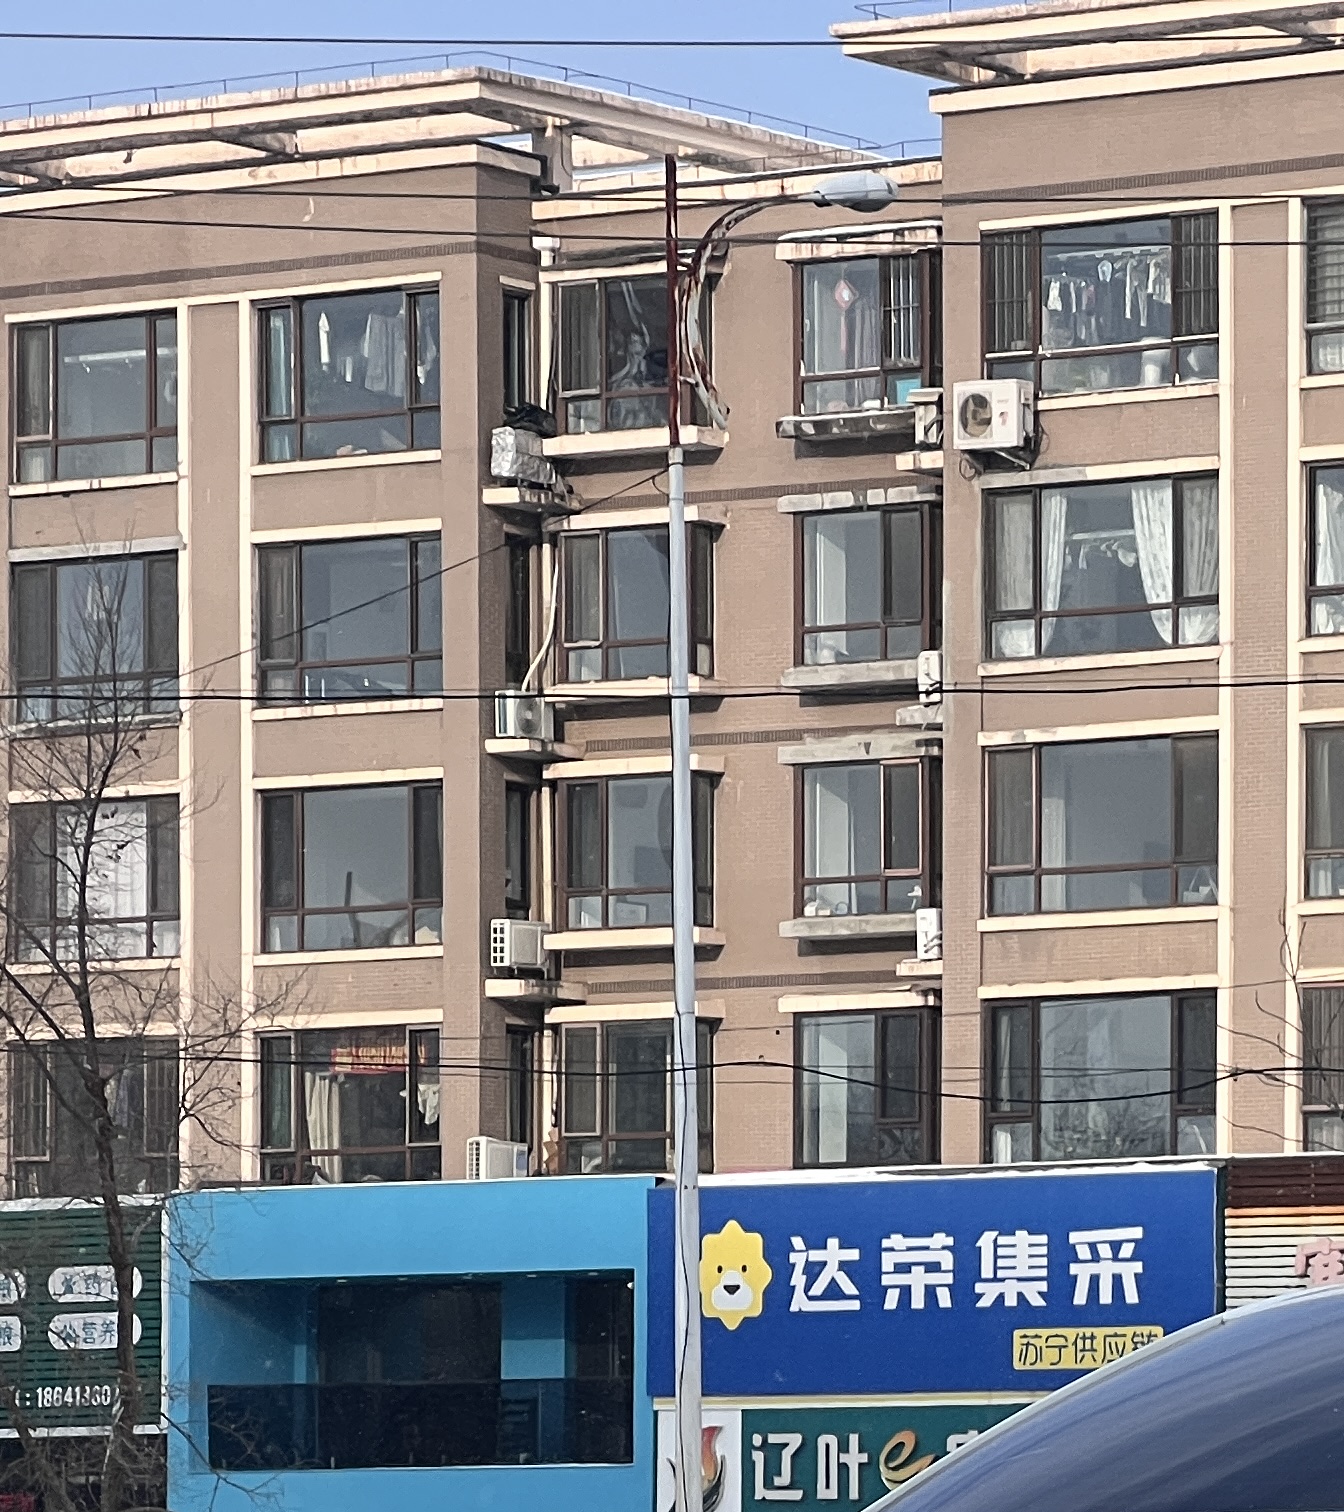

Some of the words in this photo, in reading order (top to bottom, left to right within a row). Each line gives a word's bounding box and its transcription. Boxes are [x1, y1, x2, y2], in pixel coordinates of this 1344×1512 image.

[788, 1226, 1144, 1313] 达荣集采
[751, 1429, 979, 1501] 辽叶e
